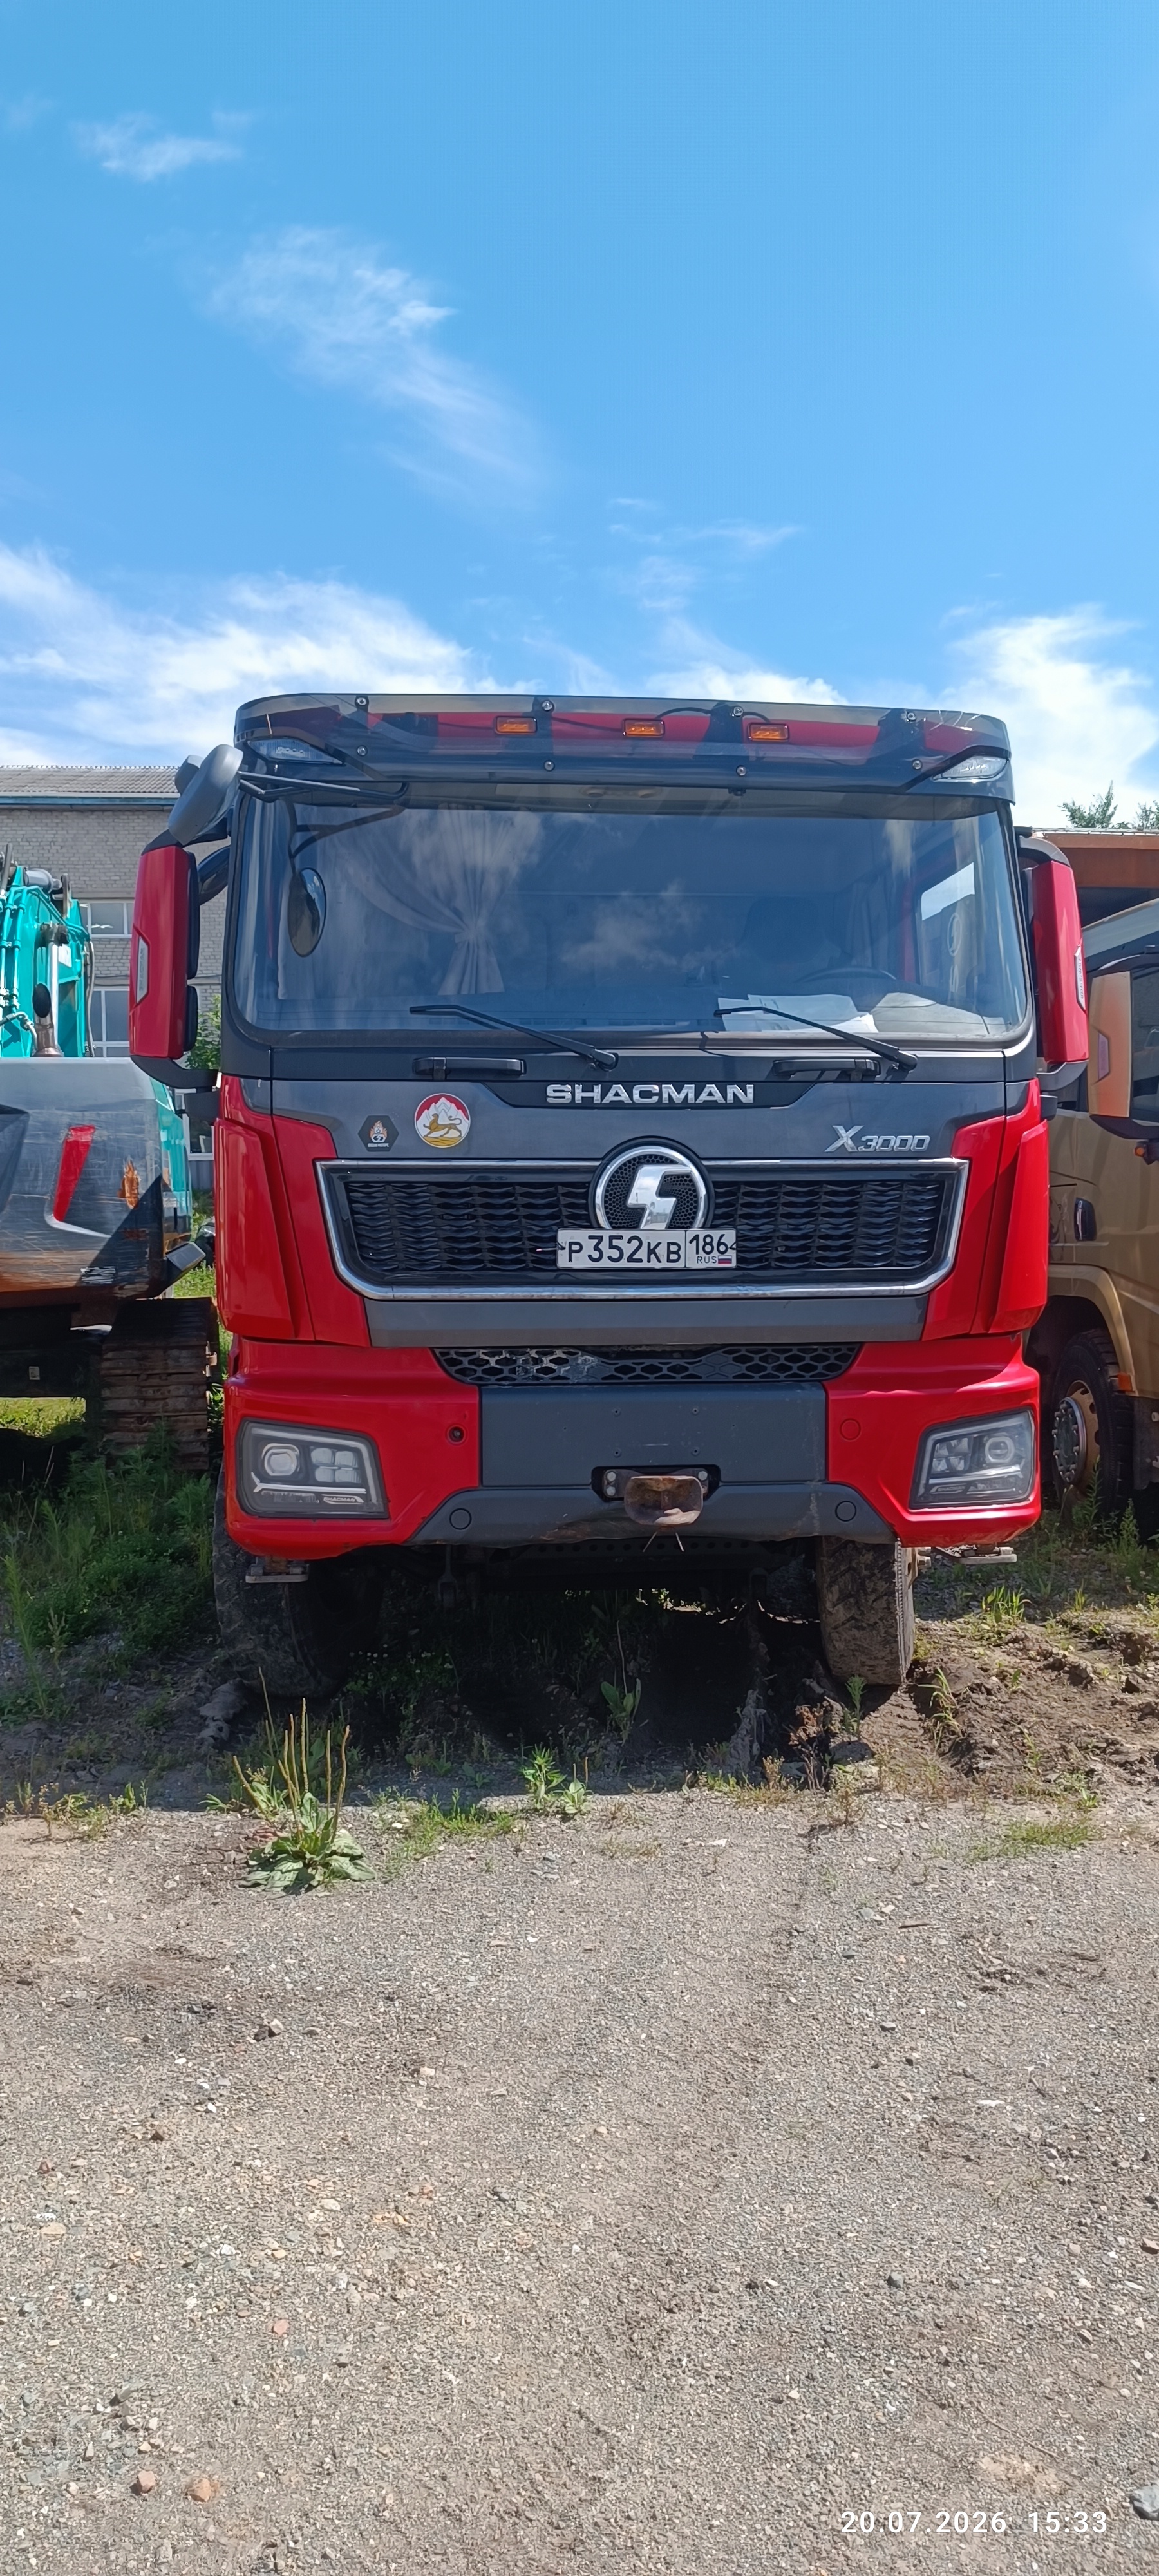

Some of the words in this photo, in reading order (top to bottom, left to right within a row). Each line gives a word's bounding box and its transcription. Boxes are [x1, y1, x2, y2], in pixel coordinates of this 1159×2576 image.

[546, 1084, 754, 1104] SHACMAN
[824, 1125, 930, 1152] X3000
[689, 1234, 728, 1255] 186
